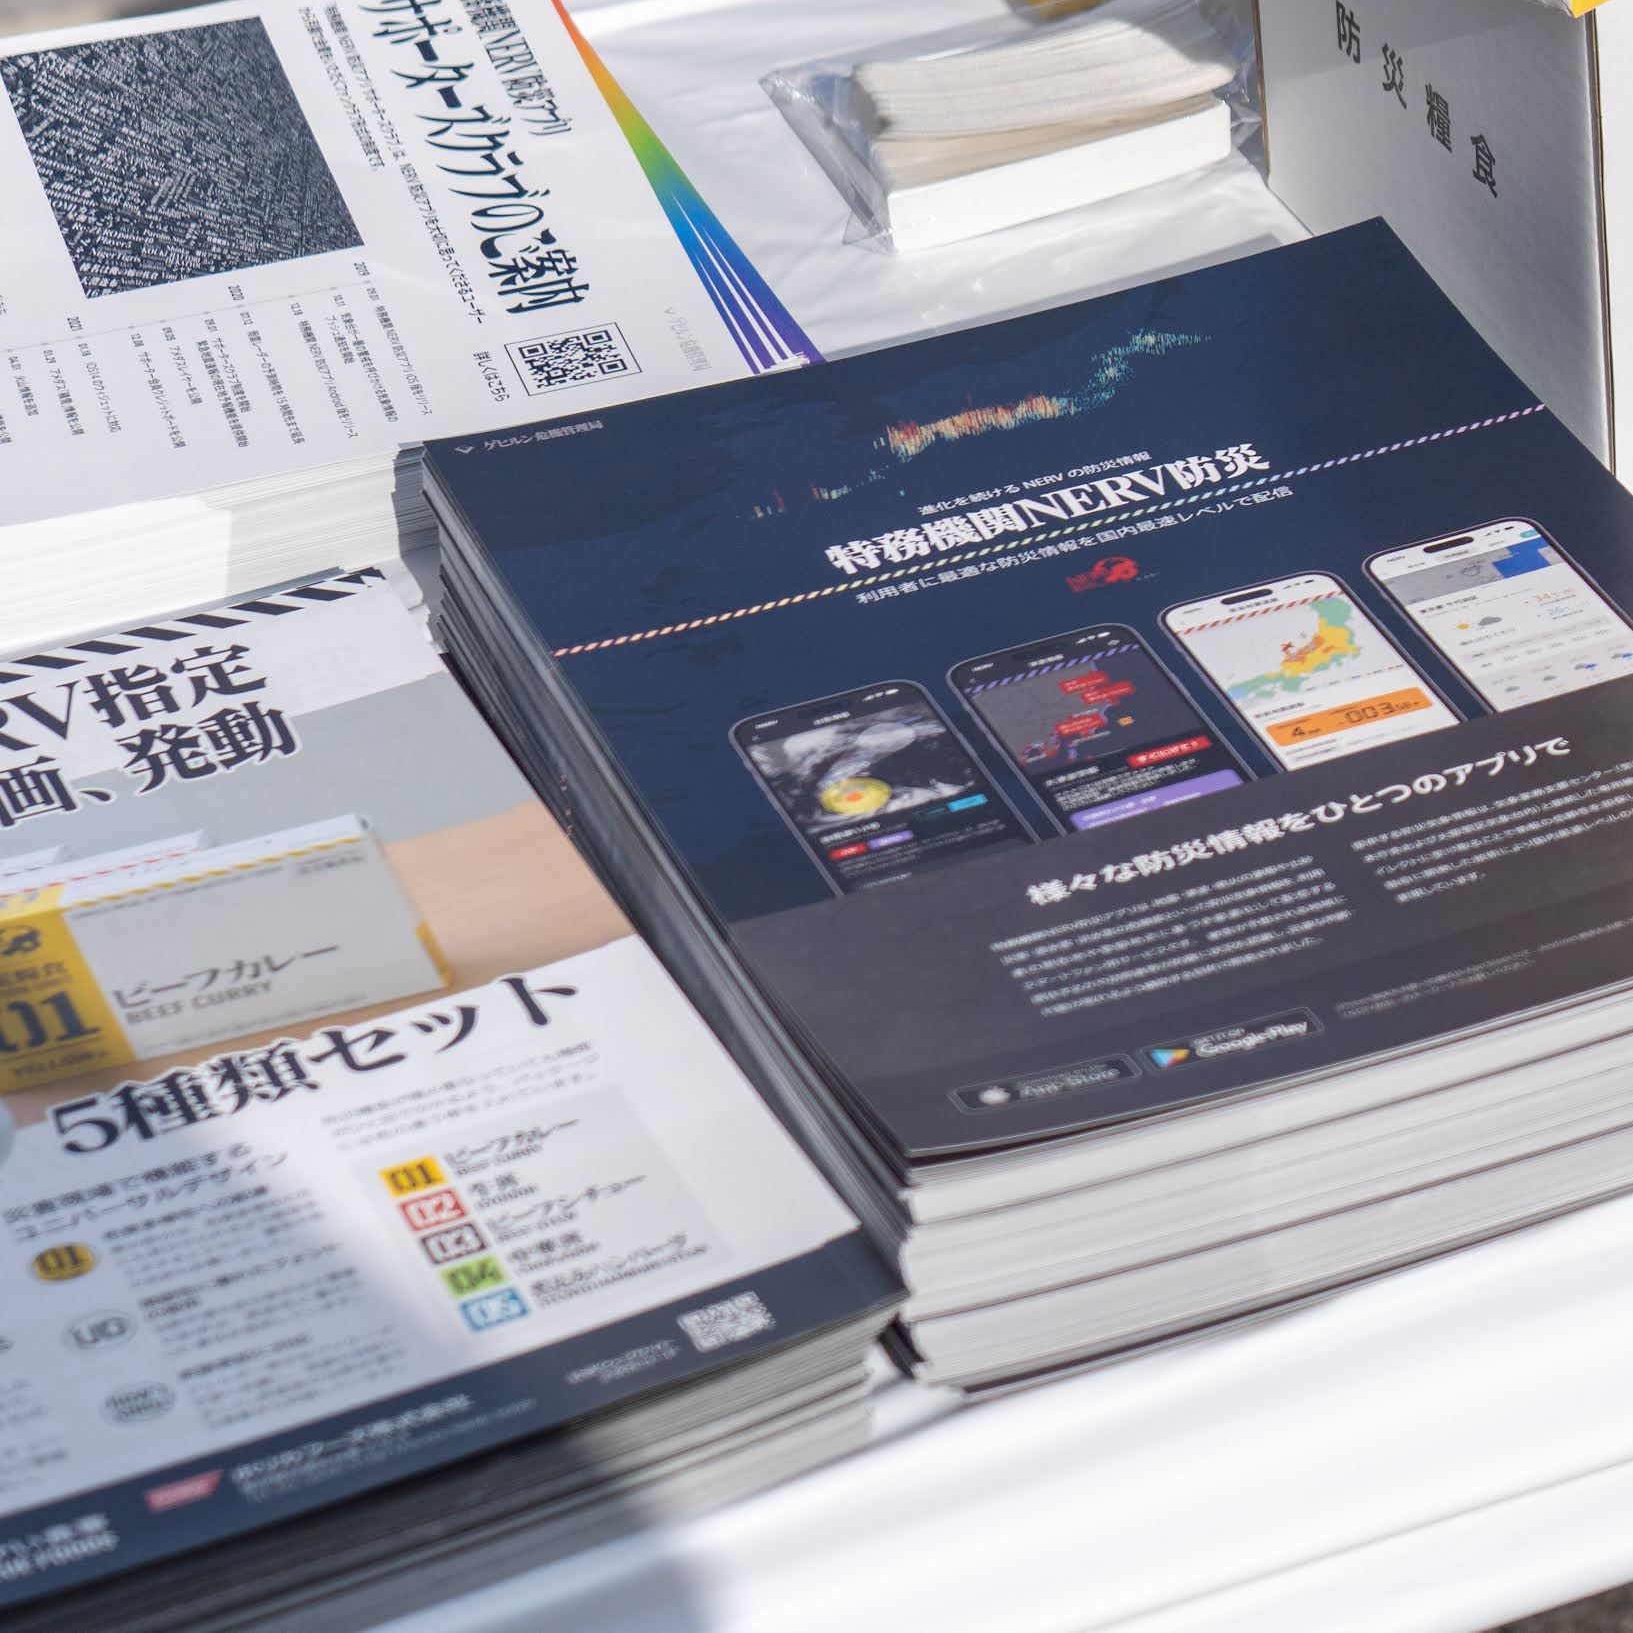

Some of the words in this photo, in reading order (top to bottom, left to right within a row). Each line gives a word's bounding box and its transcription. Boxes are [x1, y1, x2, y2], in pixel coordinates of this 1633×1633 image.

[1335, 0, 1498, 198] 防災糧食
[228, 284, 245, 302] 2020
[353, 261, 371, 278] 2019
[67, 316, 83, 332] 2021
[473, 350, 510, 403] 詳しくはこちら
[484, 419, 604, 451] ゲヒルン危機管理局
[823, 442, 1271, 575] 特務機関NERV防災
[855, 484, 1294, 605] 利用者に最適な防災情報を国内最速レベルで配信
[1026, 737, 1571, 906] 様々な防災情報をひとつのアプリで
[112, 944, 340, 1009] ビーフカレー
[191, 979, 273, 1010] CURRY
[50, 973, 581, 1157] 5種類セット
[1194, 1031, 1266, 1059] Google
[1268, 1021, 1309, 1044] Play
